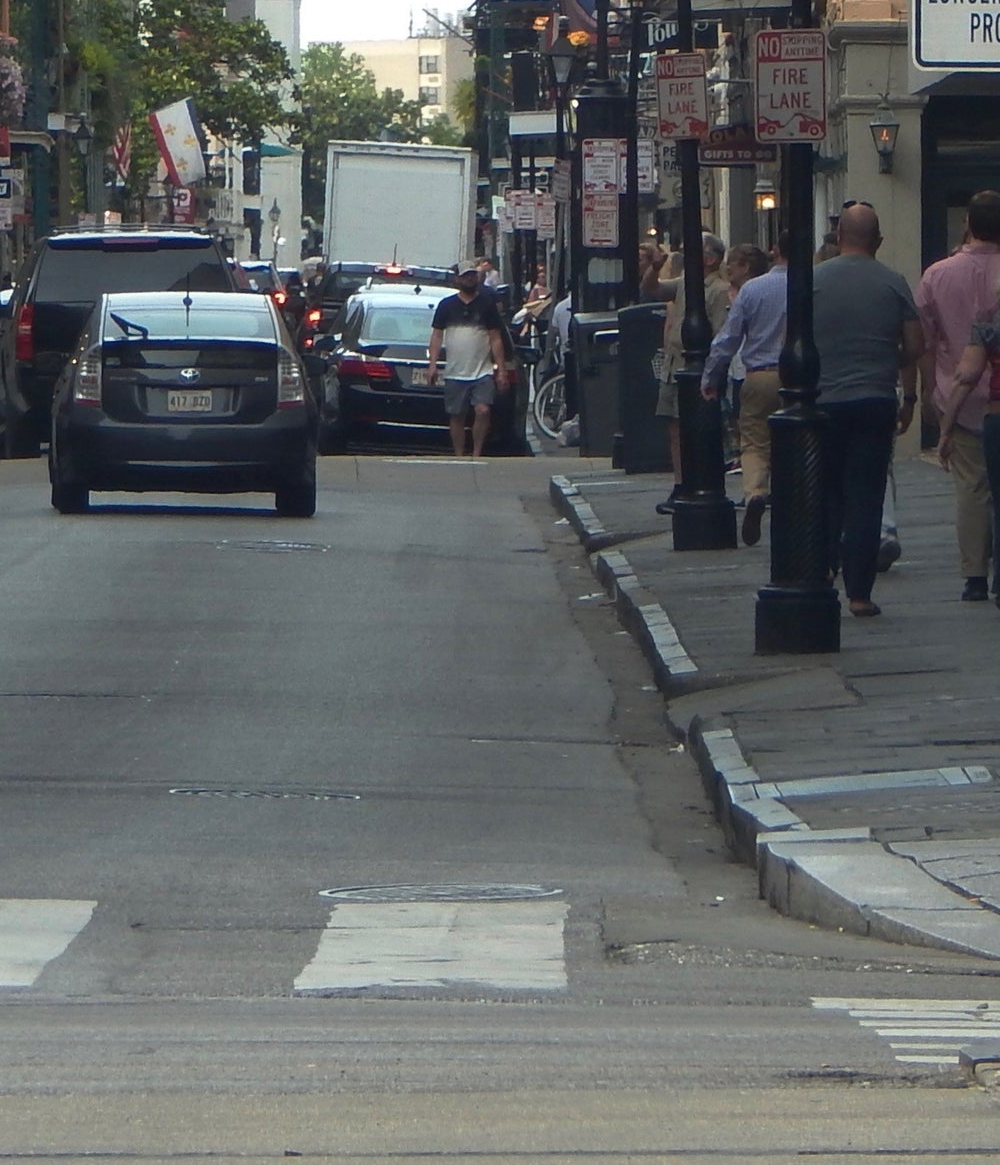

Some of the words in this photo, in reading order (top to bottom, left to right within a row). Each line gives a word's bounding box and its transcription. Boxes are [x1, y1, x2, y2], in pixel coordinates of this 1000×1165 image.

[758, 36, 780, 57] NO
[784, 46, 820, 57] ANYTIME
[657, 59, 674, 75] NO
[772, 68, 808, 85] FIRE
[668, 82, 694, 96] FIRE
[667, 100, 698, 114] LANE
[770, 92, 812, 109] LANE
[703, 149, 735, 159] GIFTS
[737, 149, 753, 159] TO
[170, 395, 187, 407] 417
